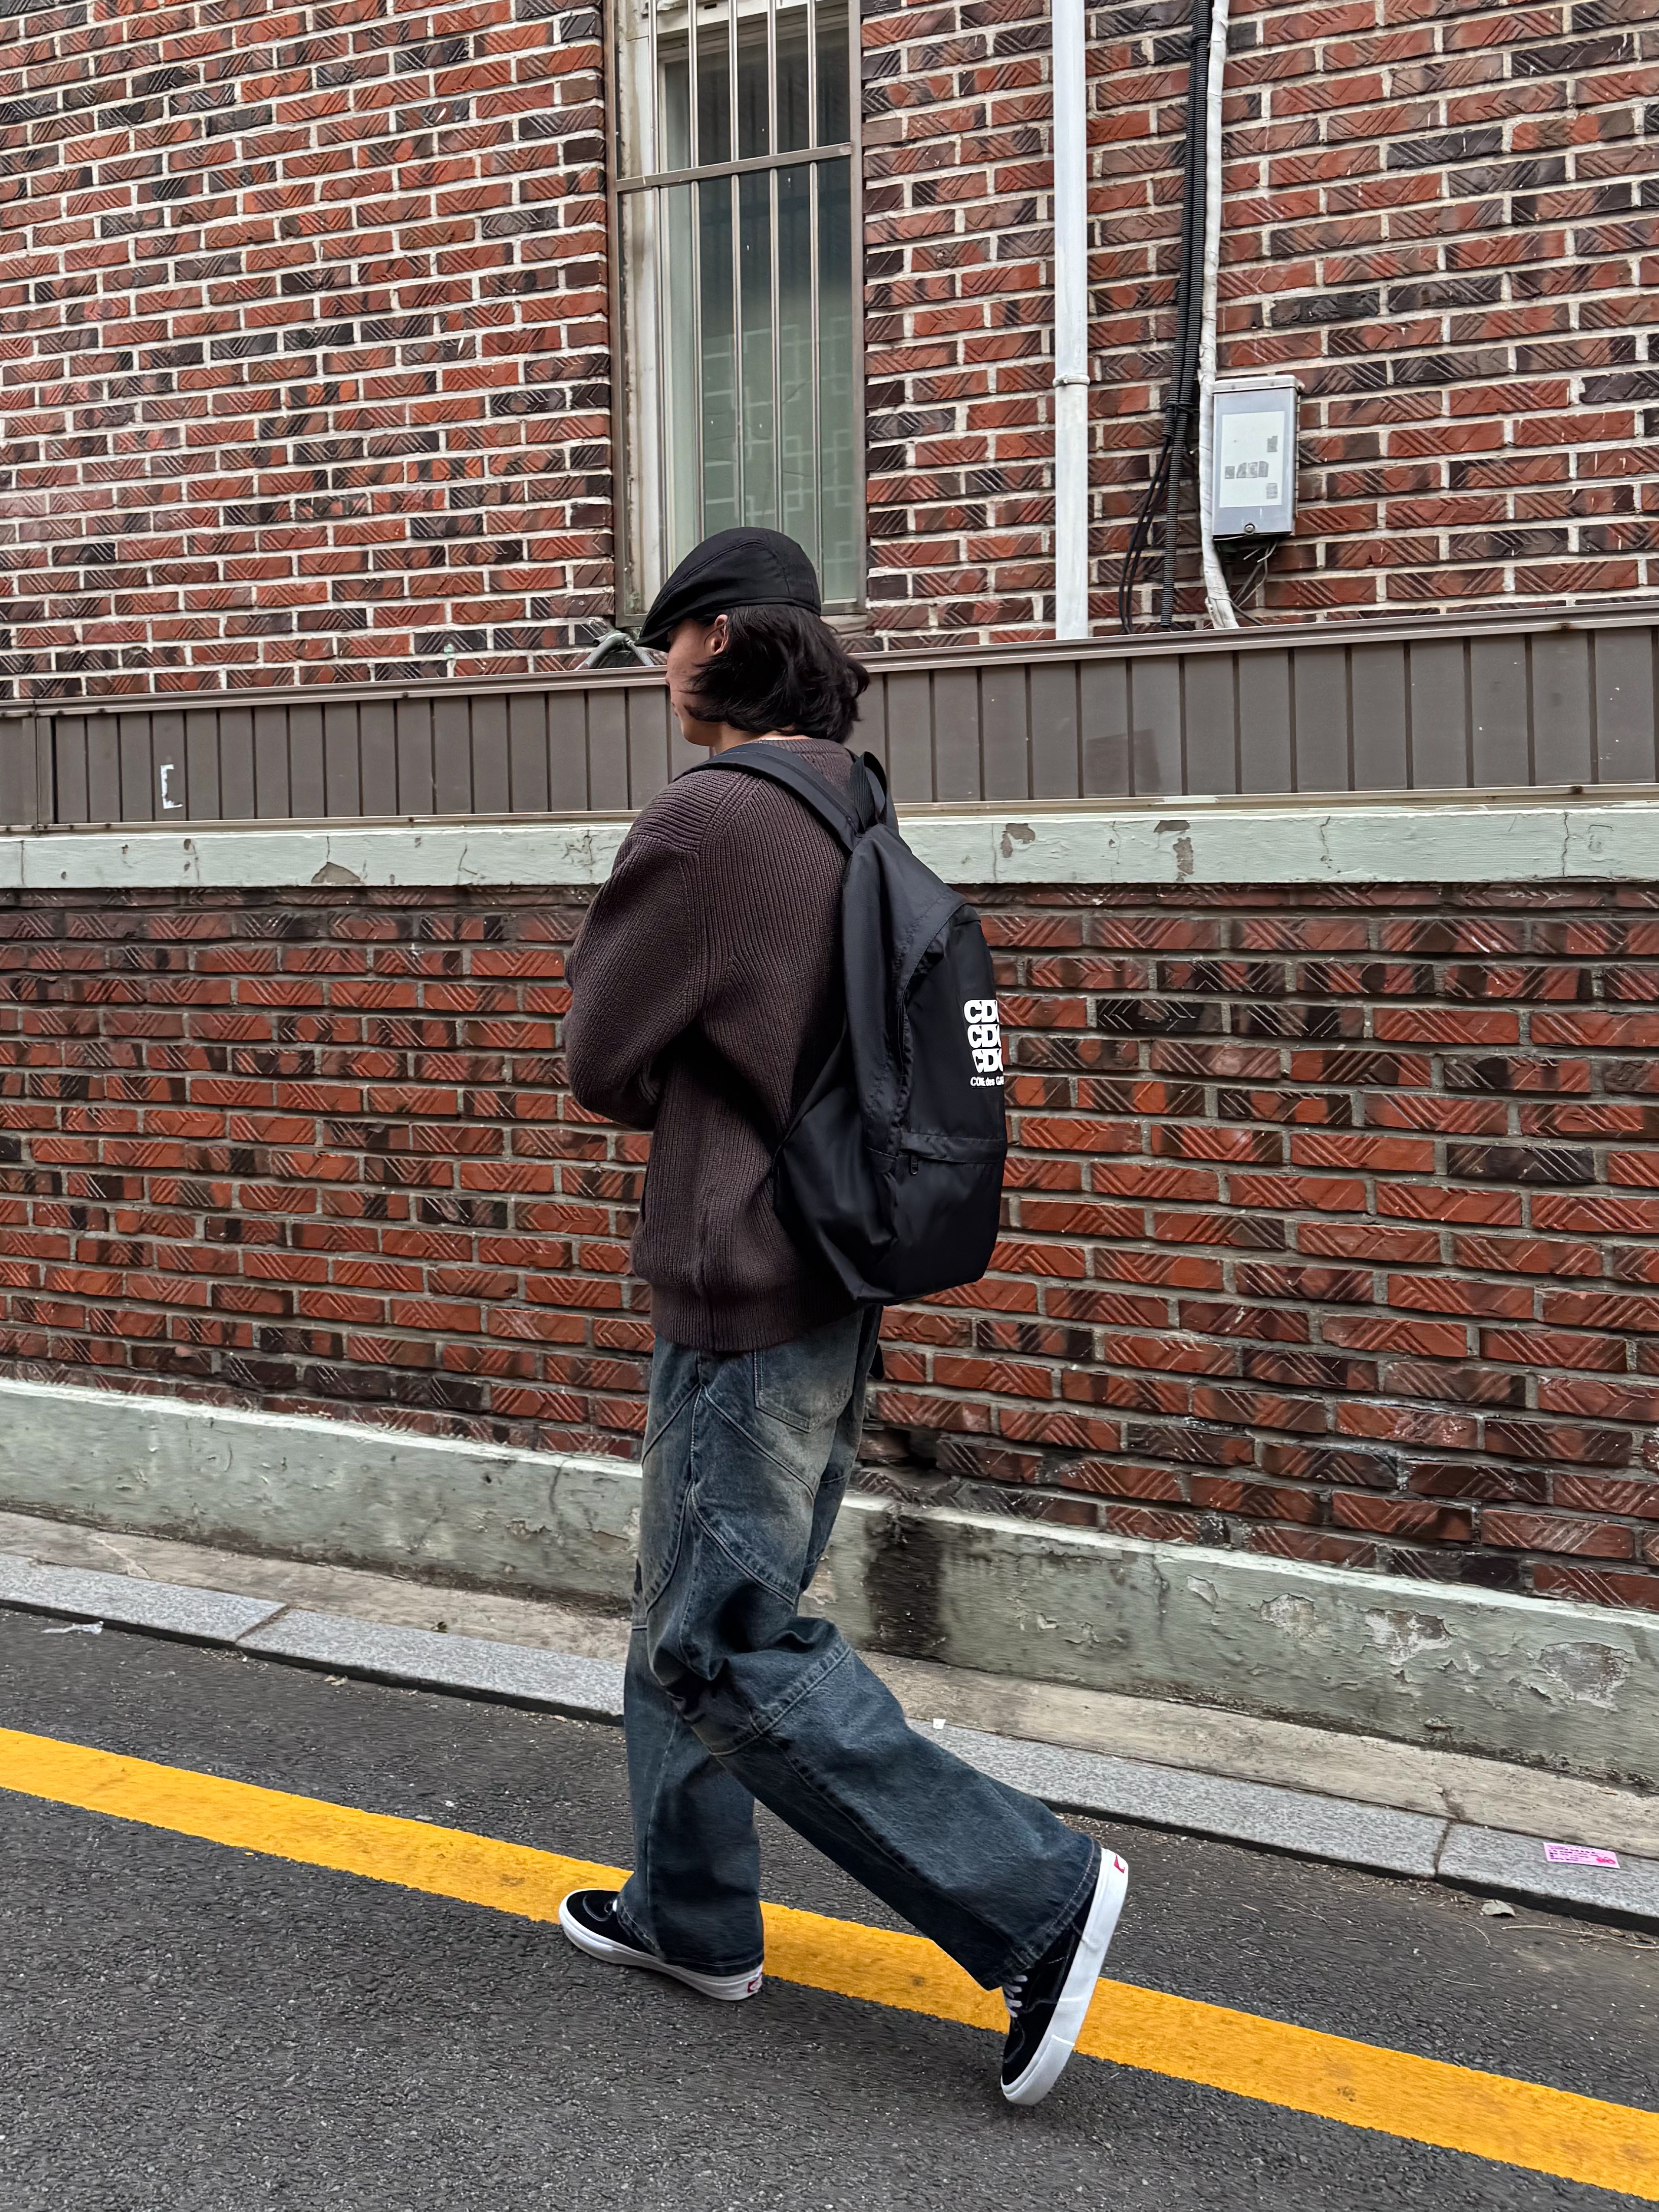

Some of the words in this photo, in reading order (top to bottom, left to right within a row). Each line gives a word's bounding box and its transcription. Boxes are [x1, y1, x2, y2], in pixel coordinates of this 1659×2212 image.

[963, 1000, 999, 1024] CD
[967, 1024, 1002, 1048] CD
[985, 1077, 995, 1086] des
